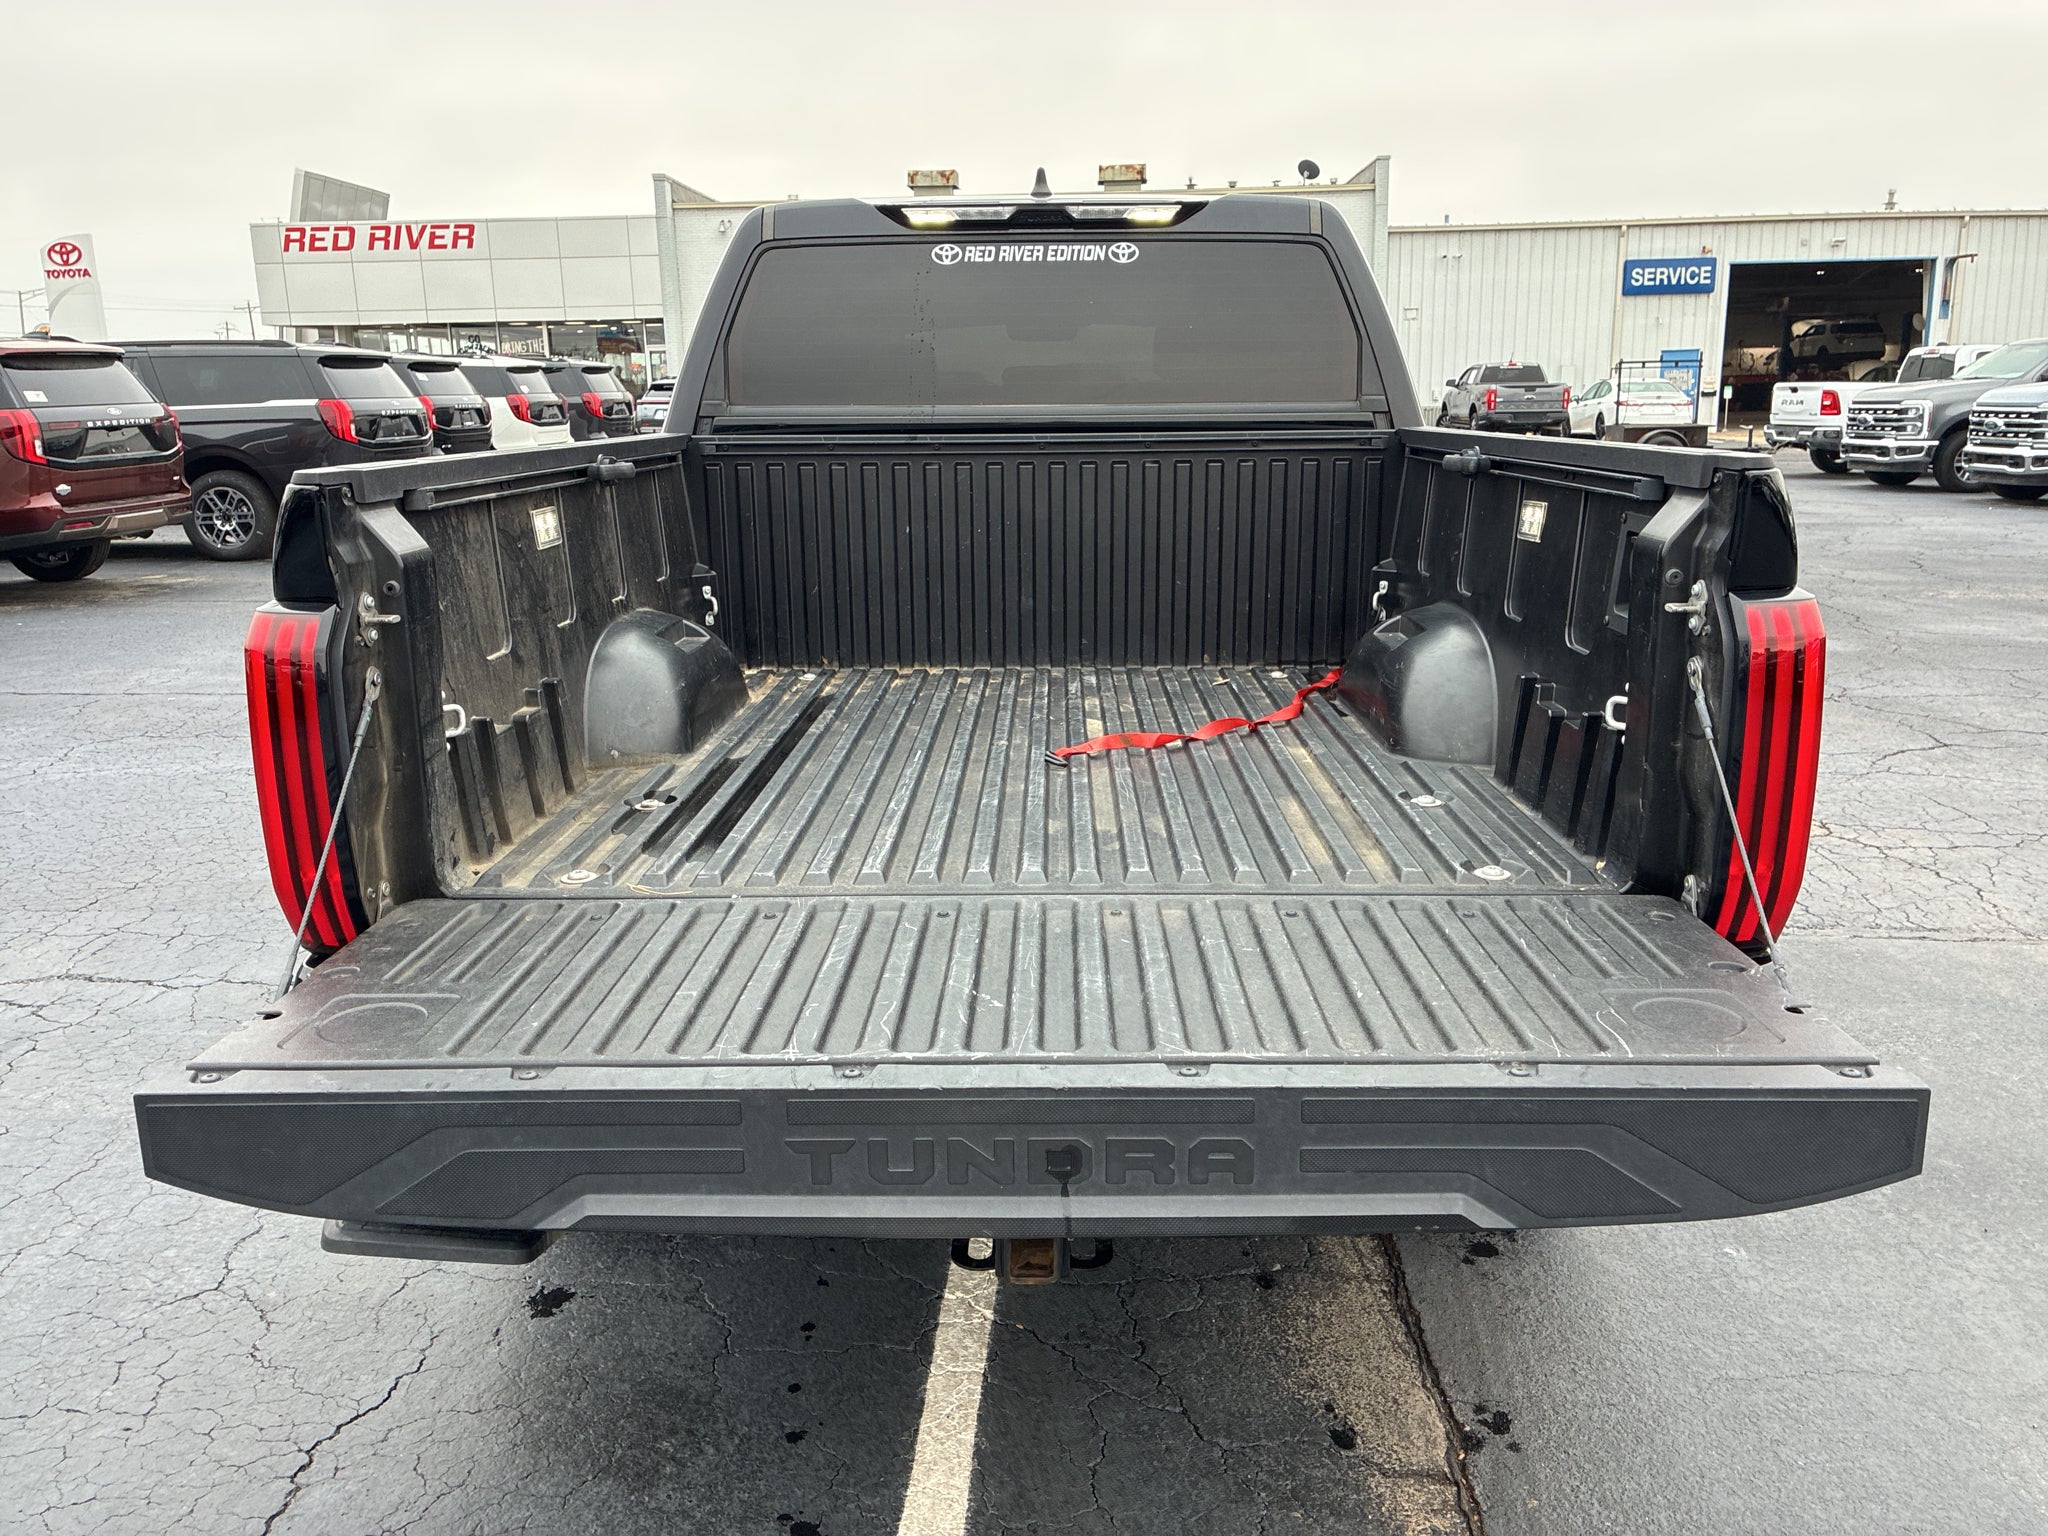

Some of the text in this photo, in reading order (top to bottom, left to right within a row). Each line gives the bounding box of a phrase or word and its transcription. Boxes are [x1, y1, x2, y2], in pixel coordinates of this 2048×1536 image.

[283, 223, 476, 253] RED RIVER
[964, 244, 1107, 262] RED RIVER EDITION
[44, 268, 92, 280] TOYOTA
[1630, 265, 1713, 287] SERVICE
[86, 418, 152, 429] EXPEDITION
[783, 1136, 1256, 1186] TUNDRA
